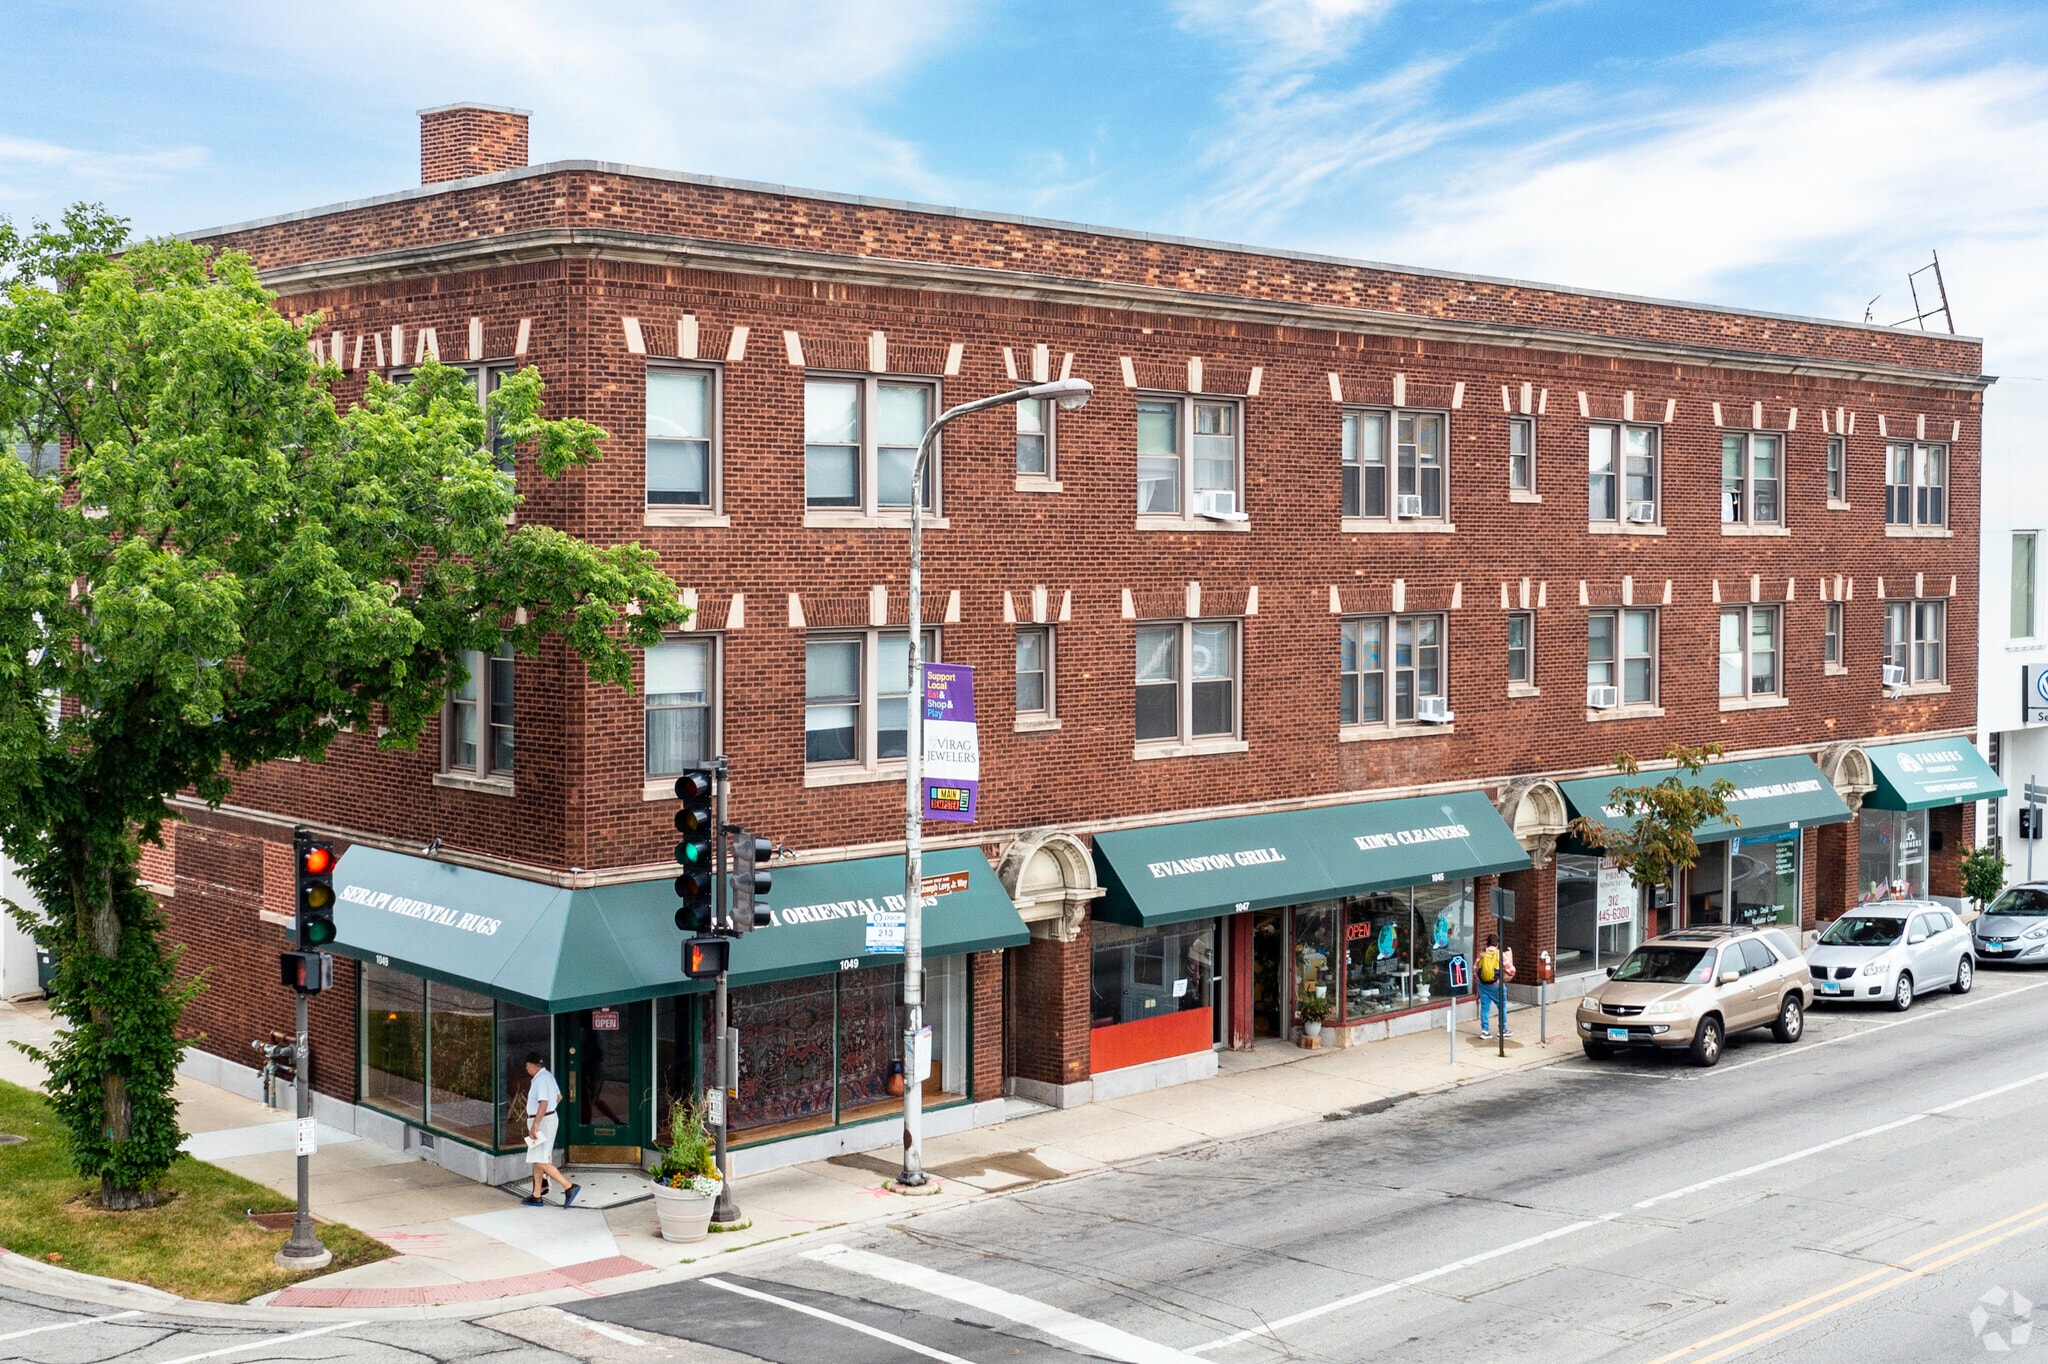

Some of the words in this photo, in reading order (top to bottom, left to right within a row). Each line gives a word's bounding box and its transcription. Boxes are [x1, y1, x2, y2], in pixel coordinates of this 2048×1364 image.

[927, 671, 956, 682] Support
[927, 681, 947, 690] Local
[927, 690, 939, 698] Eat
[939, 691, 945, 699] &
[927, 699, 947, 710] Shop
[947, 700, 954, 709] &
[927, 709, 943, 719] Play
[937, 737, 971, 751] VIRAG
[927, 751, 976, 763] JEWELERS
[1915, 750, 1964, 764] FARMERS
[941, 790, 956, 798] MAIN
[1353, 833, 1399, 850] KIM'S
[1396, 824, 1470, 844] CLEANERS
[1900, 839, 1922, 849] FARMERS
[1147, 853, 1235, 878] EVANSTON
[1234, 847, 1286, 867] GRILL
[1431, 872, 1445, 882] 1045
[957, 878, 968, 889] Way
[1608, 894, 1620, 906] 312
[338, 885, 393, 910] SERAPI
[388, 896, 459, 926] ORIENTAL
[456, 912, 502, 936] RUGS
[784, 898, 884, 925] ORIENTAL
[1235, 902, 1250, 913] 1047
[1598, 906, 1630, 921] 445-6300
[878, 929, 894, 937] 213
[1347, 922, 1370, 940] OPEN
[376, 954, 389, 966] 1049
[839, 958, 859, 970] 1049
[595, 1019, 617, 1028] OPEN
